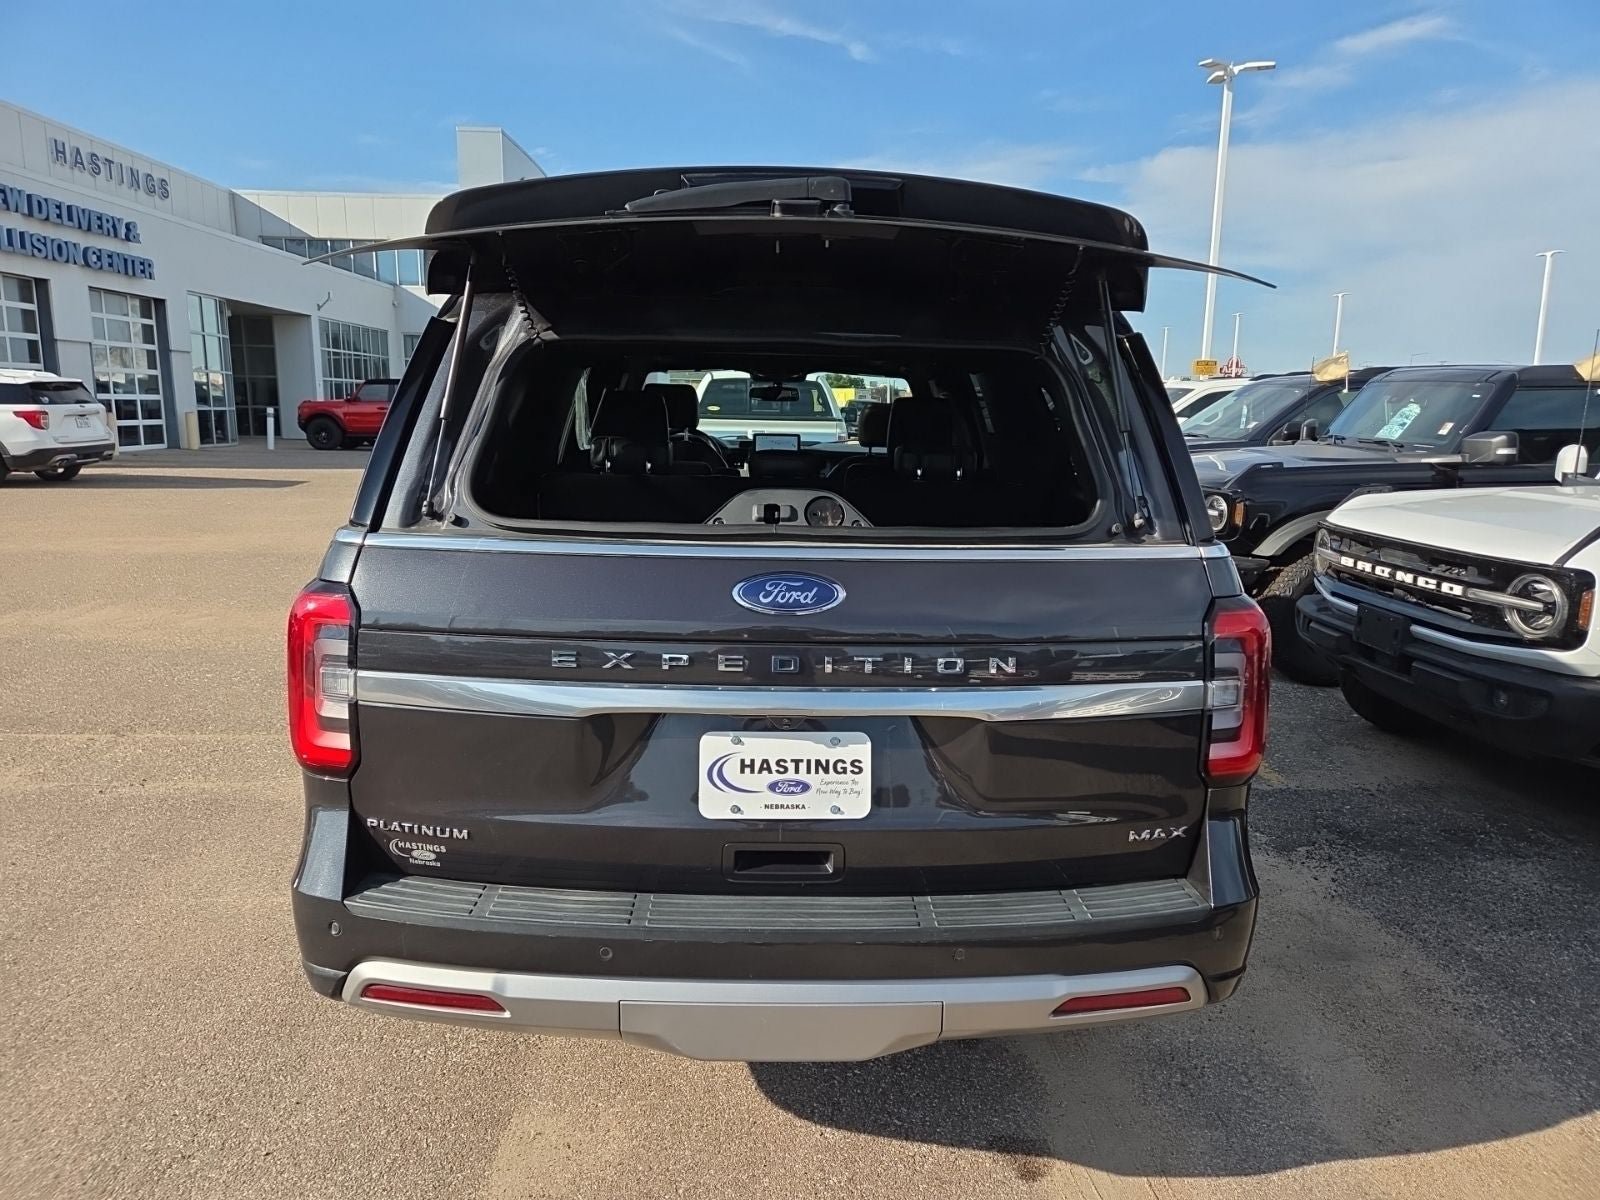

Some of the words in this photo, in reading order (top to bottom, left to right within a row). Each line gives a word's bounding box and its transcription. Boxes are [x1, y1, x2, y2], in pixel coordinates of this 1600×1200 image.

[52, 138, 171, 200] HASTINGS
[27, 193, 125, 239] DELIVERY
[124, 221, 142, 244] &
[82, 246, 156, 281] CENTER
[1340, 556, 1464, 596] BRONCO
[758, 581, 817, 605] Ford
[551, 649, 1017, 675] EXPEDITION
[739, 758, 864, 775] HASTINGS
[366, 818, 469, 840] PLATINUM
[1128, 825, 1188, 842] MAX
[398, 840, 447, 853] HASTINGS
[409, 858, 441, 867] Nebraska
